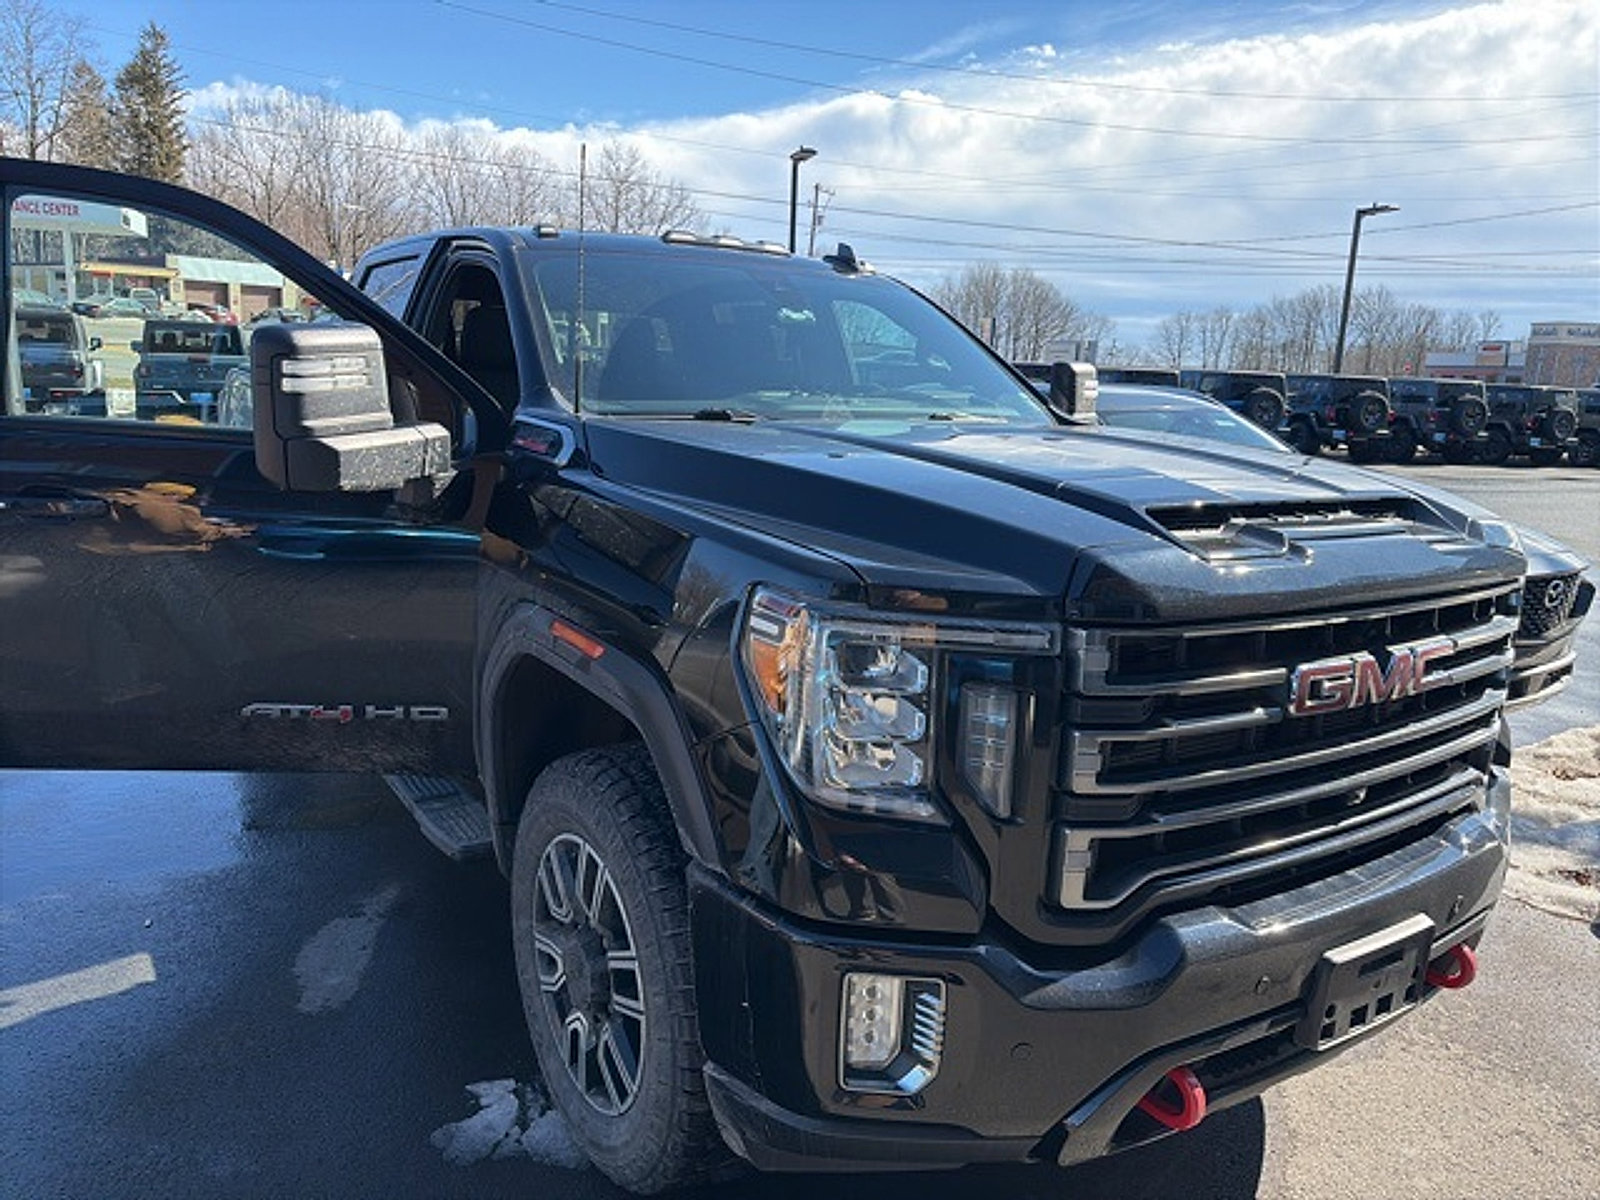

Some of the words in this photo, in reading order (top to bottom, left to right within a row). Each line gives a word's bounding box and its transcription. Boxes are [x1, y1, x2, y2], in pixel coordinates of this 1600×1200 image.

[42, 202, 79, 215] CENTER
[1288, 636, 1457, 716] GMC
[239, 702, 352, 723] AT4
[365, 704, 449, 720] HD
